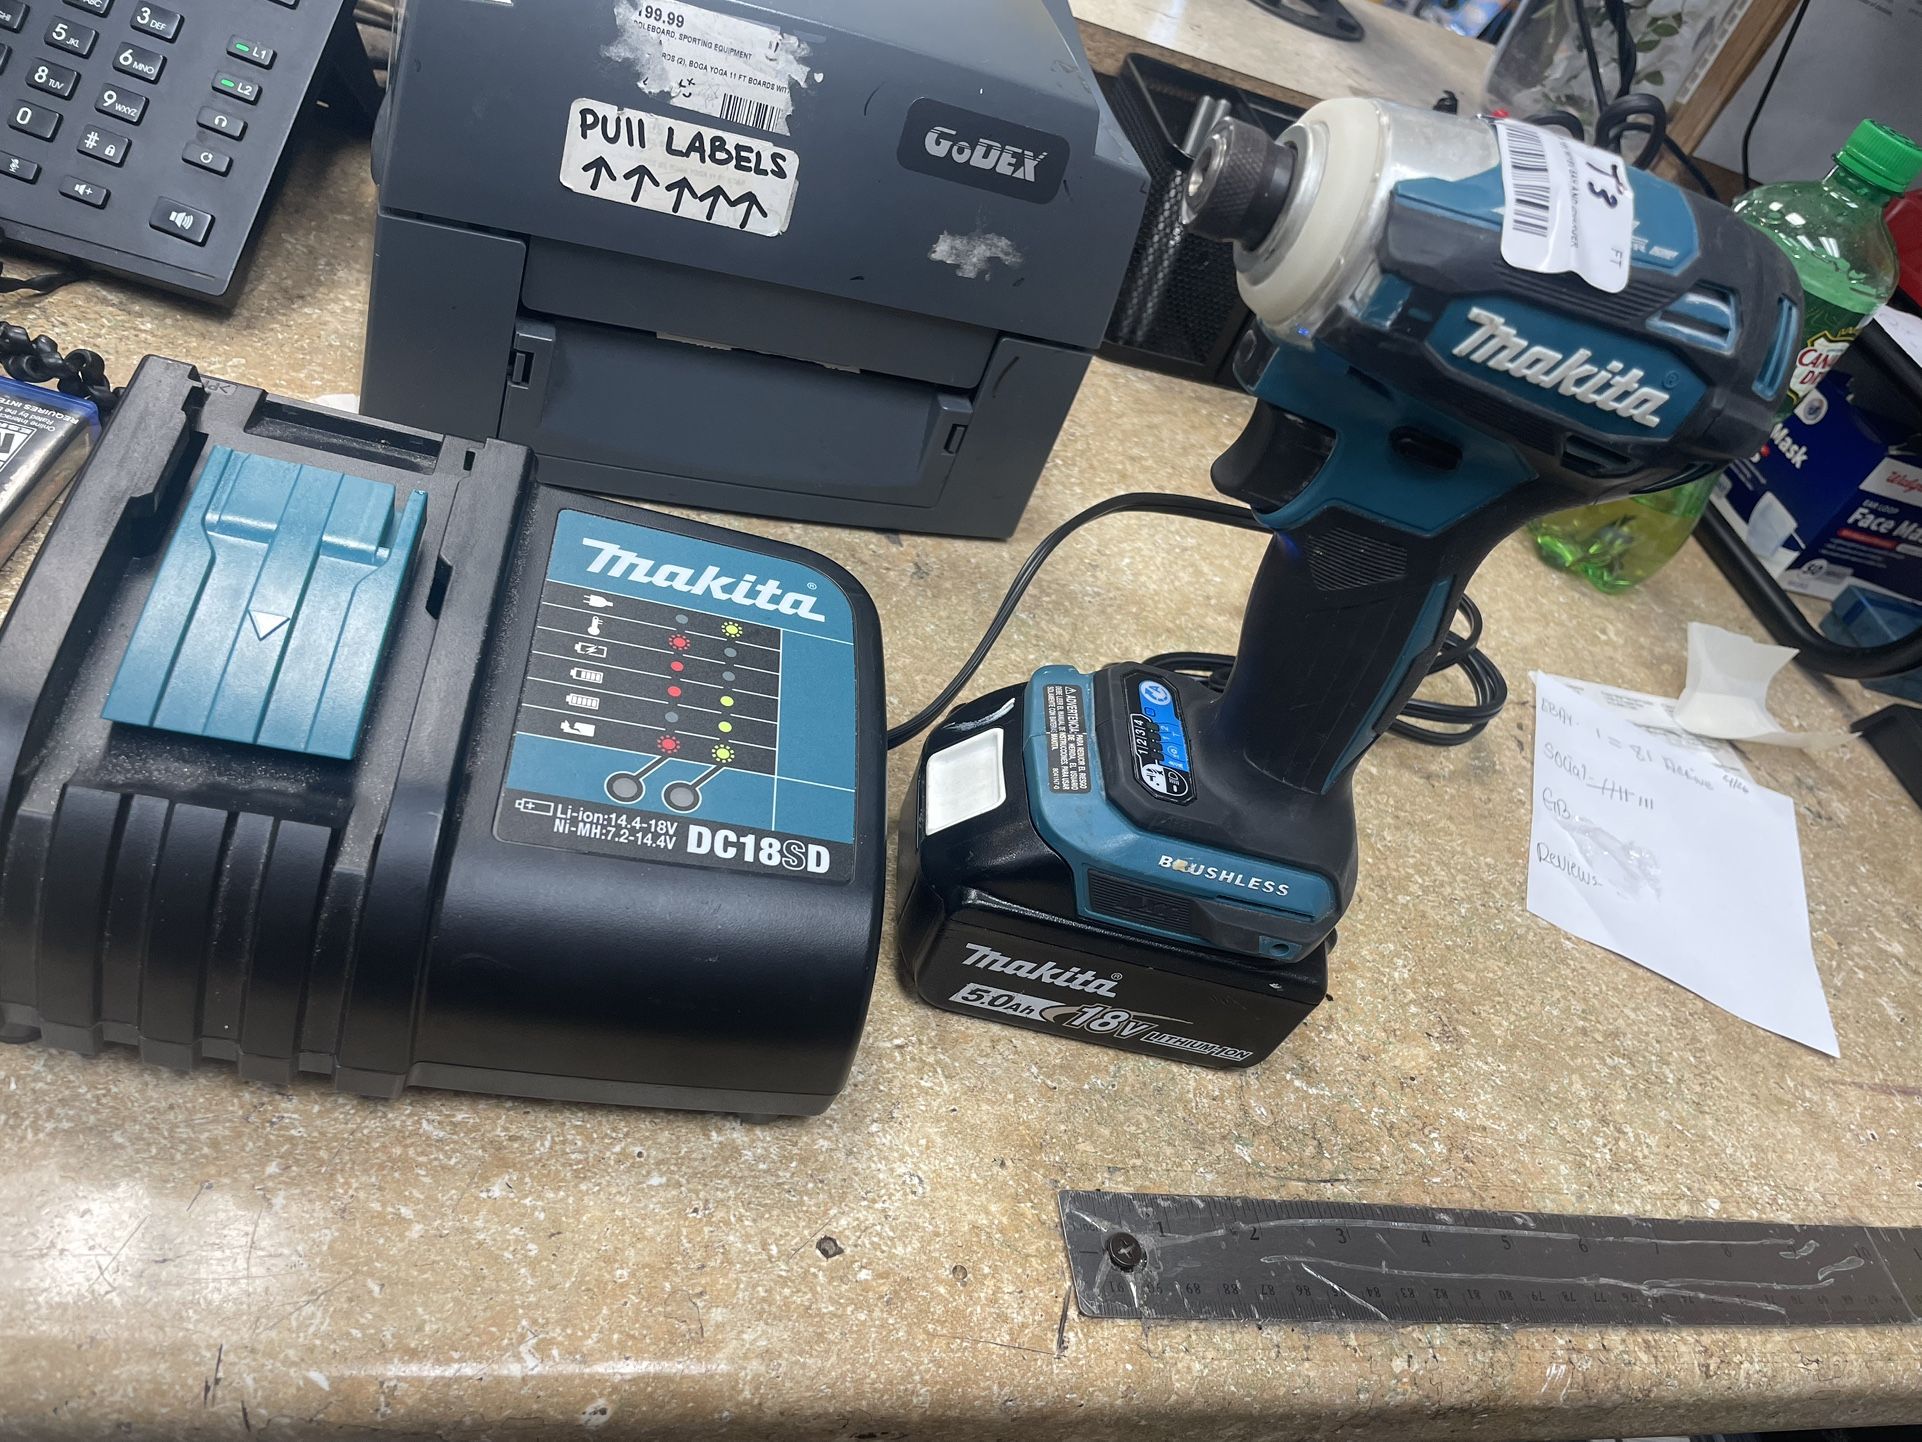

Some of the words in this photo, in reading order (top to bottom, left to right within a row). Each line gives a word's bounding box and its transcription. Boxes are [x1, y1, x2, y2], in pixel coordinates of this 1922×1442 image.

[137, 7, 151, 24] 3
[151, 20, 166, 31] DEF
[53, 24, 68, 41] 5
[67, 37, 80, 48] JKL
[678, 33, 713, 49] SPORTING
[714, 43, 752, 60] EQUIPMENT
[119, 49, 133, 66] 6
[133, 61, 154, 75] MNO
[253, 46, 267, 60] L1
[34, 66, 48, 83] 8
[49, 78, 64, 90] TUV
[688, 60, 708, 72] BOGA
[709, 65, 728, 77] YOGA
[738, 73, 747, 82] FT
[748, 76, 776, 91] BOARDS
[237, 82, 252, 96] L2
[16, 107, 32, 124] 0
[103, 90, 117, 107] 9
[116, 103, 137, 117] WXYZ
[666, 126, 788, 181] LABELS
[23, 404, 80, 425] REQUIRES
[29, 416, 54, 426] Rated
[1769, 422, 1808, 469] Mask
[1847, 506, 1895, 533] Face
[553, 818, 677, 850] Ni-MH:7.2-14.4V
[556, 803, 678, 835] Li-ion:14.4-18V
[686, 824, 831, 874] DC18SD
[1158, 854, 1290, 897] BUSHLESS
[961, 987, 1035, 1016] 5.0Ah
[1063, 1003, 1158, 1040] 18V
[1141, 1031, 1254, 1062] LITHIUM-ION
[1250, 1227, 1260, 1241] 2
[1335, 1227, 1347, 1244] 3
[1421, 1231, 1432, 1247] 4
[1501, 1235, 1511, 1250] 5
[1578, 1238, 1589, 1253] 6
[1186, 1283, 1201, 1295] 89
[1223, 1284, 1239, 1295] 88
[1261, 1284, 1276, 1296] 87
[1296, 1285, 1312, 1296] 86
